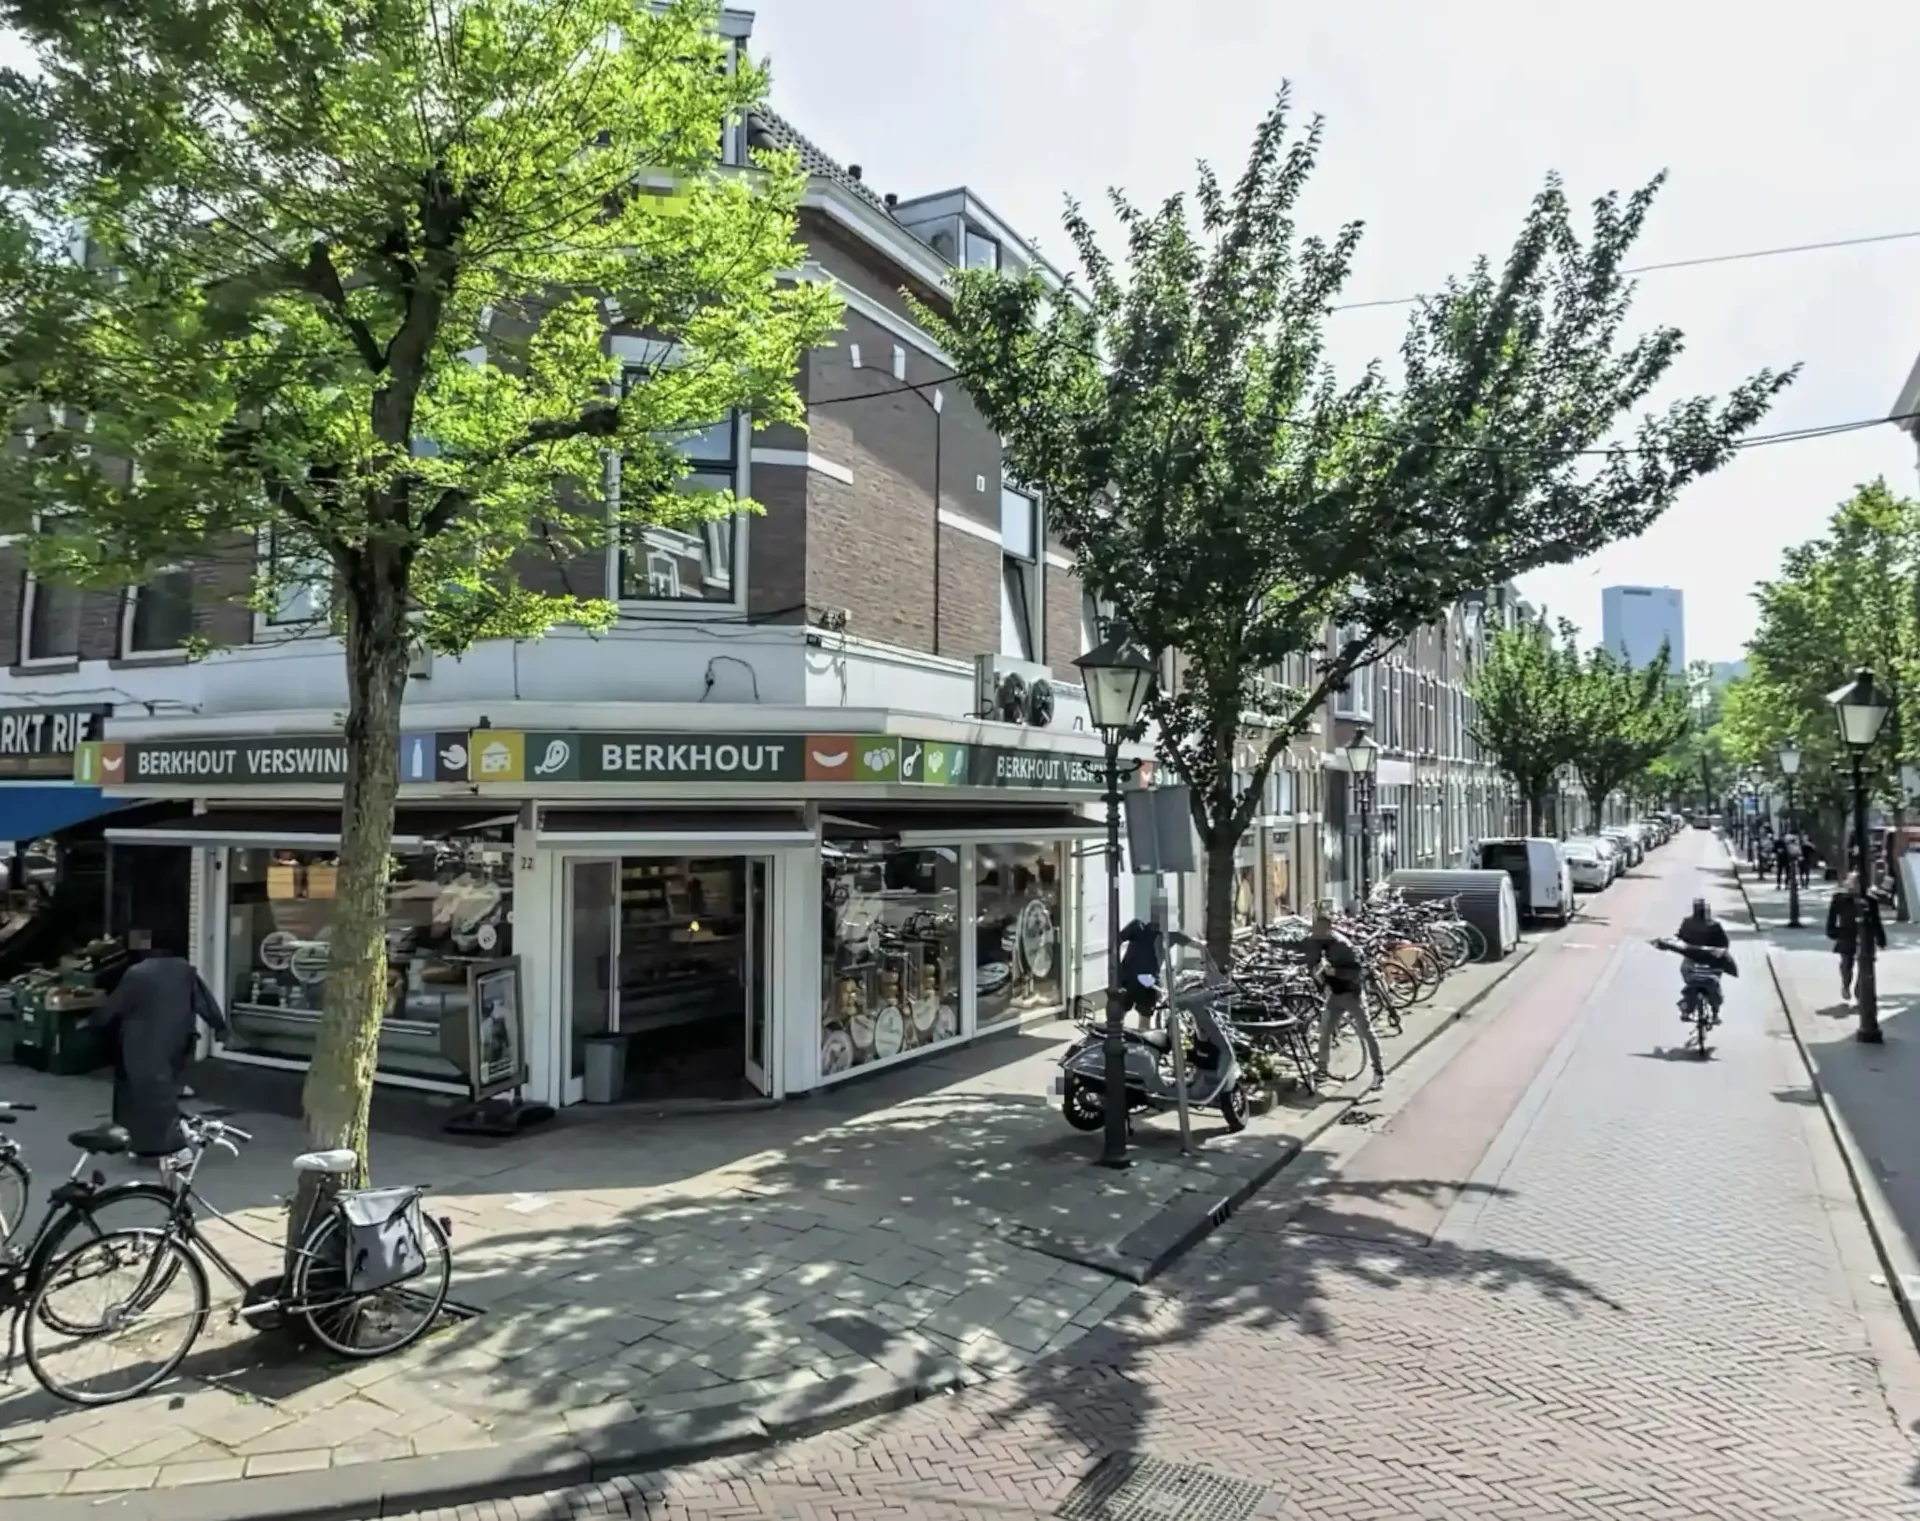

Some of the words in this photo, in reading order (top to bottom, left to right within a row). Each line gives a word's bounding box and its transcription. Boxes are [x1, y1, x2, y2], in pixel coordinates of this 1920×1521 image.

[1, 714, 46, 754] RKT
[138, 748, 236, 776] BERKHOUT
[601, 743, 785, 772] BERKHOUT
[996, 754, 1060, 781] BERKHOUT
